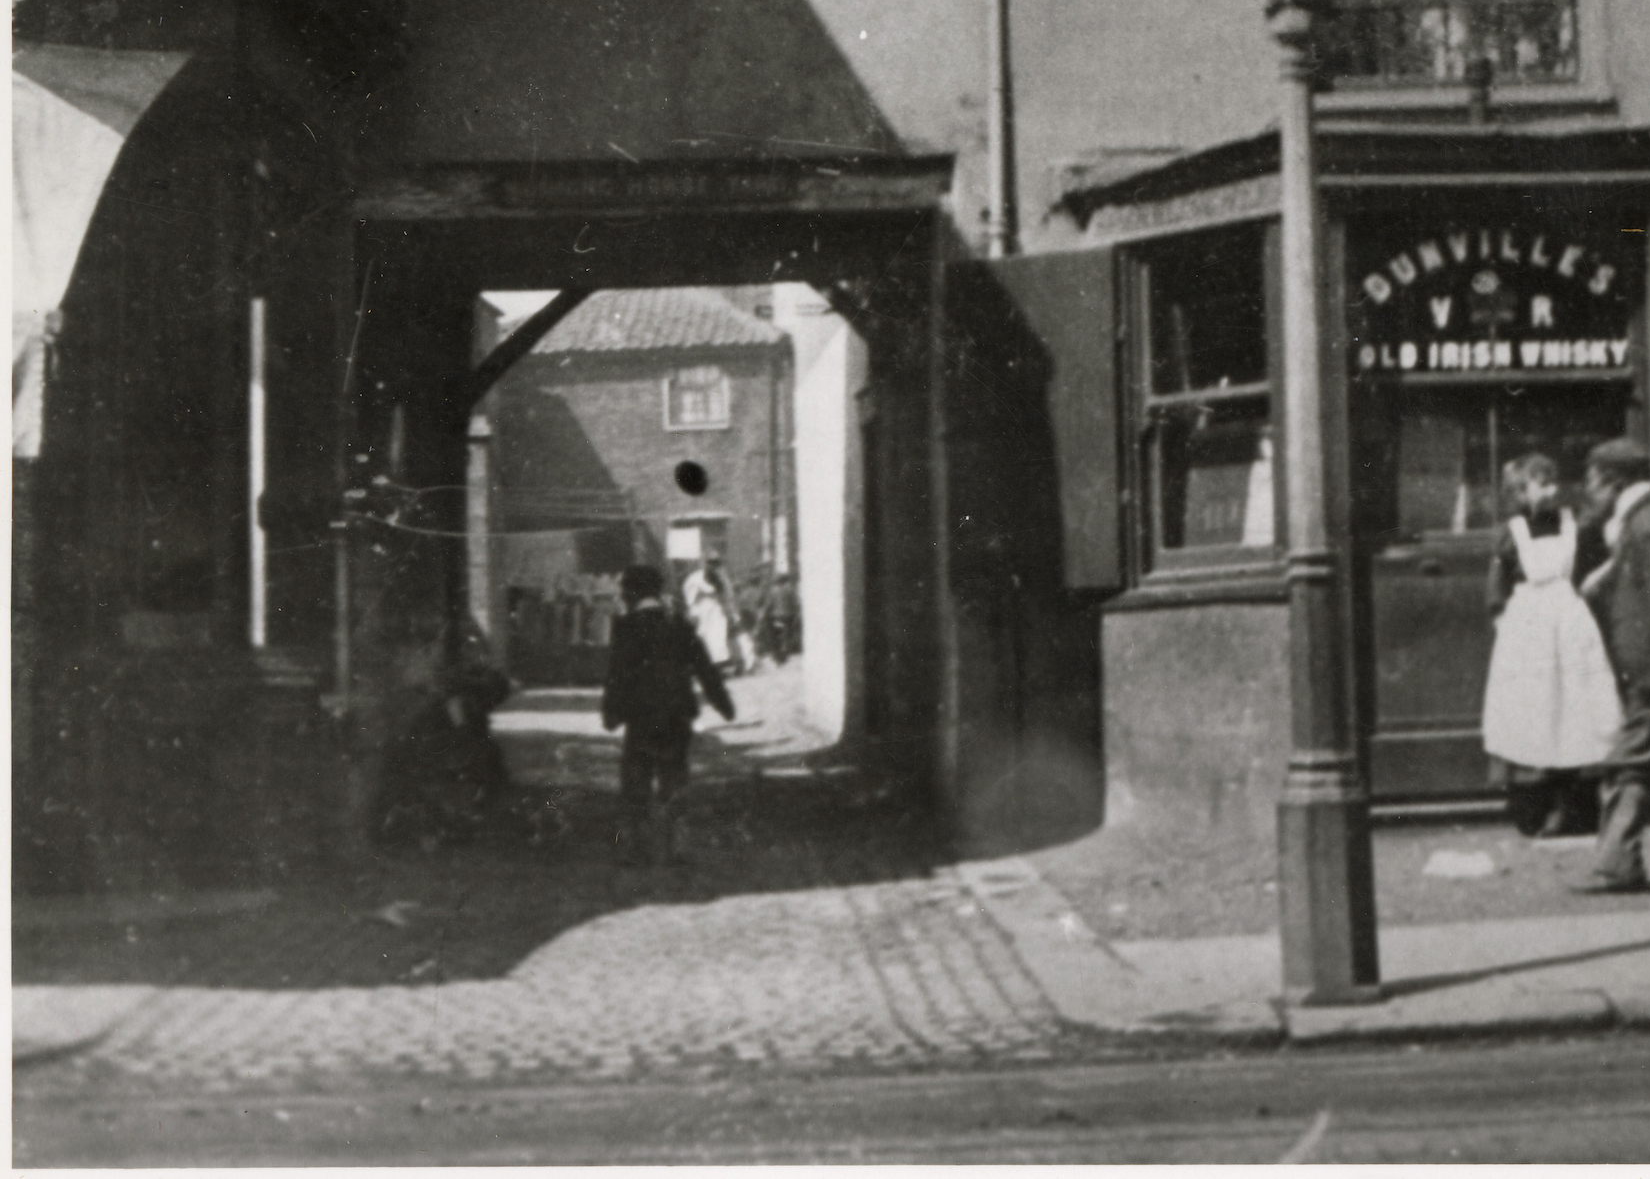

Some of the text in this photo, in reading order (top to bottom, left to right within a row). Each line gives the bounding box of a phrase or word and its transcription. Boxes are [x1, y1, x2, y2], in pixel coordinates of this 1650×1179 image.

[1428, 292, 1556, 331] V R
[1358, 337, 1632, 370] OLD IRISH WHISKY
